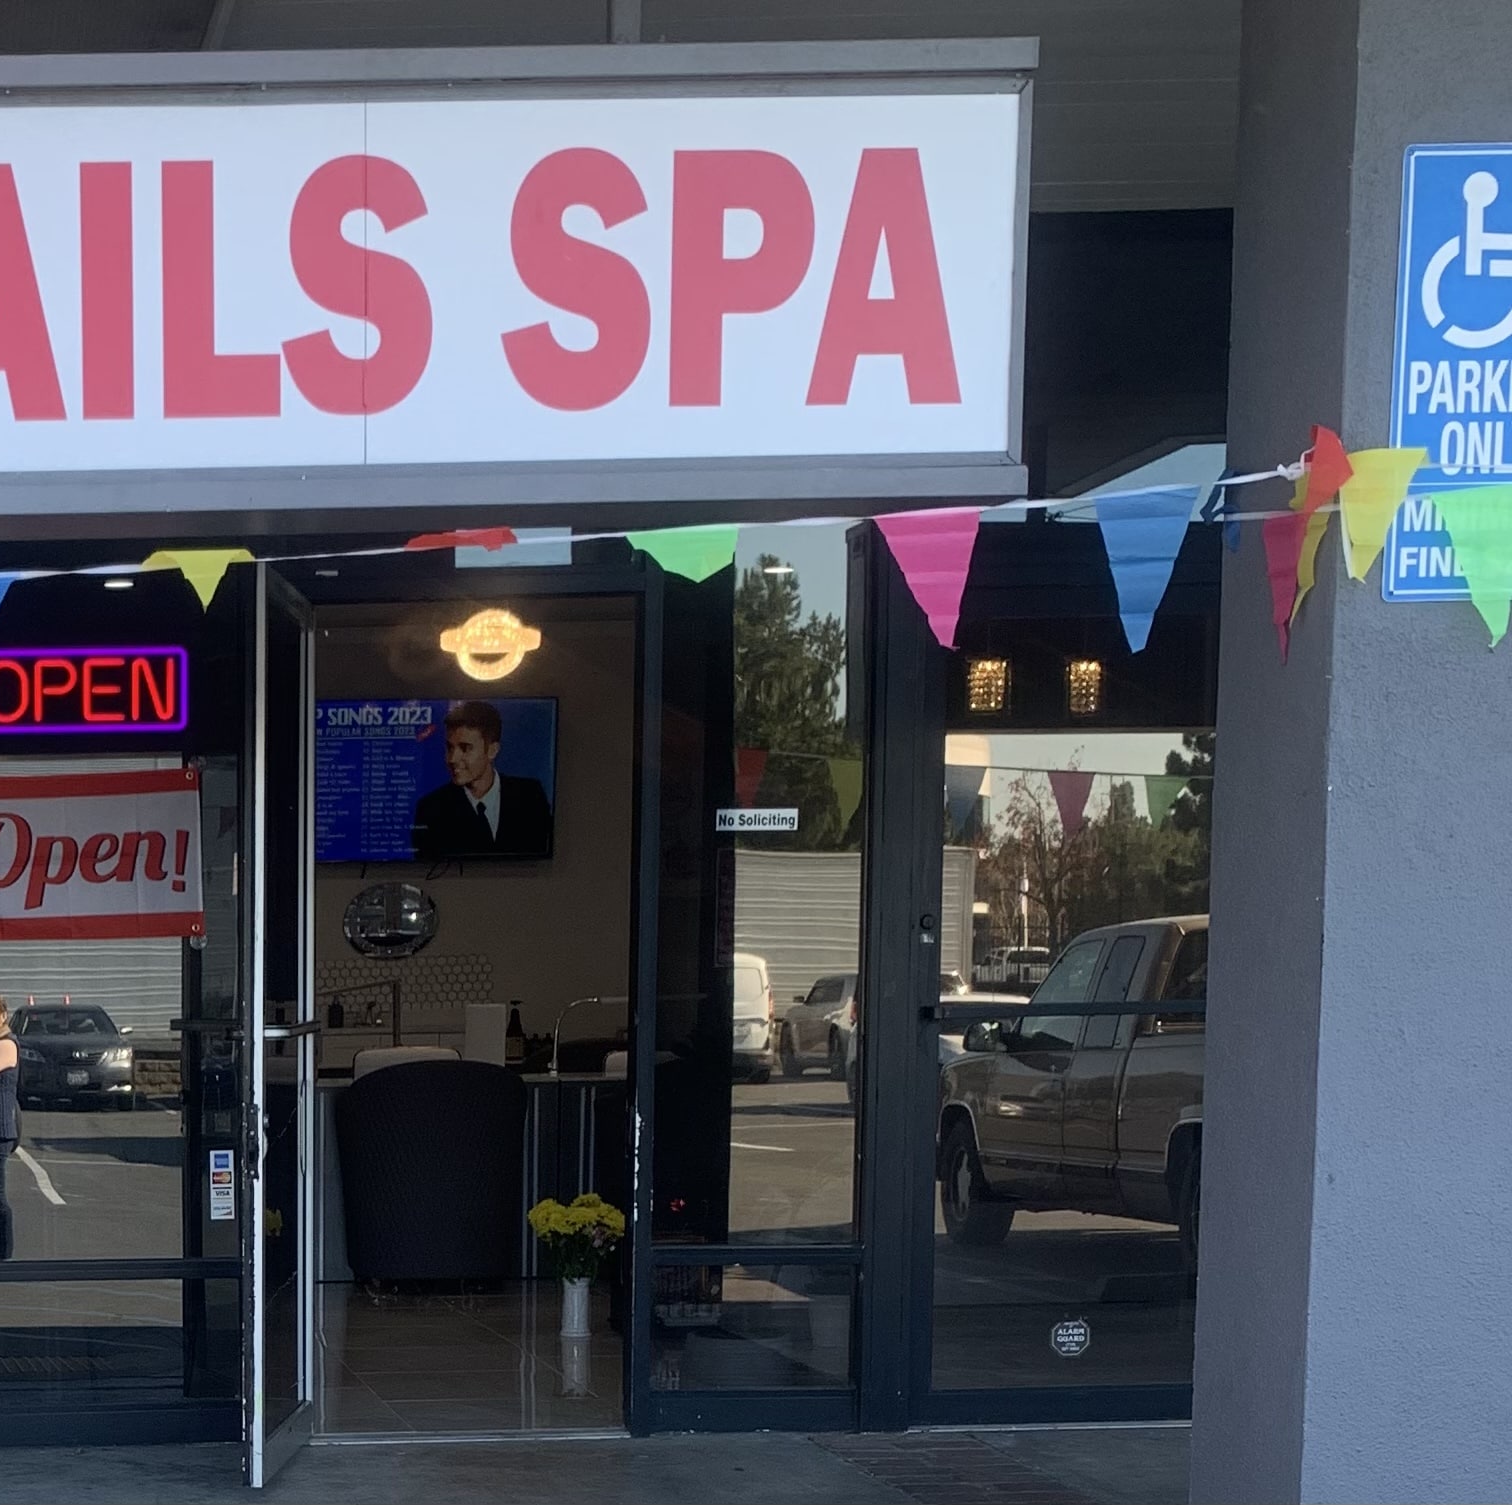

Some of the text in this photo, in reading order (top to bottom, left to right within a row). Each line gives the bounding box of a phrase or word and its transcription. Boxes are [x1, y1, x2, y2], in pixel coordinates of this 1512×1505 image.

[501, 147, 962, 412] SPA
[1403, 498, 1448, 532] MI
[327, 706, 383, 726] SONGS
[387, 705, 433, 726] 2023
[718, 813, 796, 829] No Soliciting
